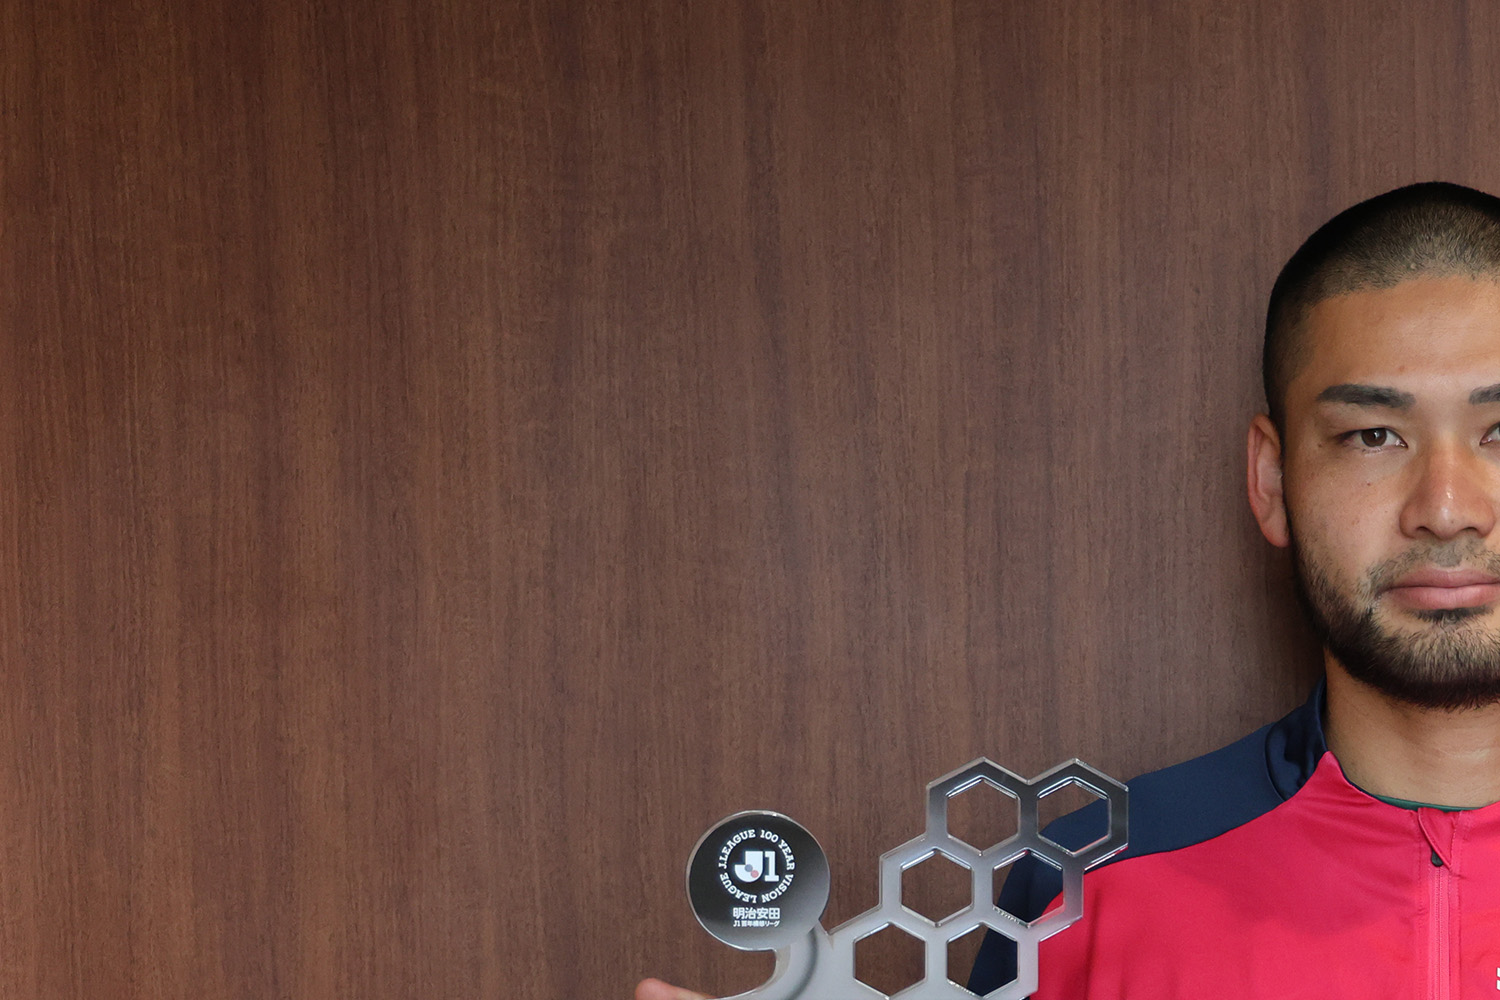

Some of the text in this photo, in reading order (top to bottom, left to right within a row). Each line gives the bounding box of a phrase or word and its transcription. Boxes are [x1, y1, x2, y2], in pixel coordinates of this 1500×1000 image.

[760, 829, 779, 843] 100
[734, 851, 779, 883] J1
[778, 839, 796, 870] YEAR
[719, 872, 757, 903] LEAGUE
[761, 874, 794, 903] VISION
[733, 907, 780, 919] 明治安田
